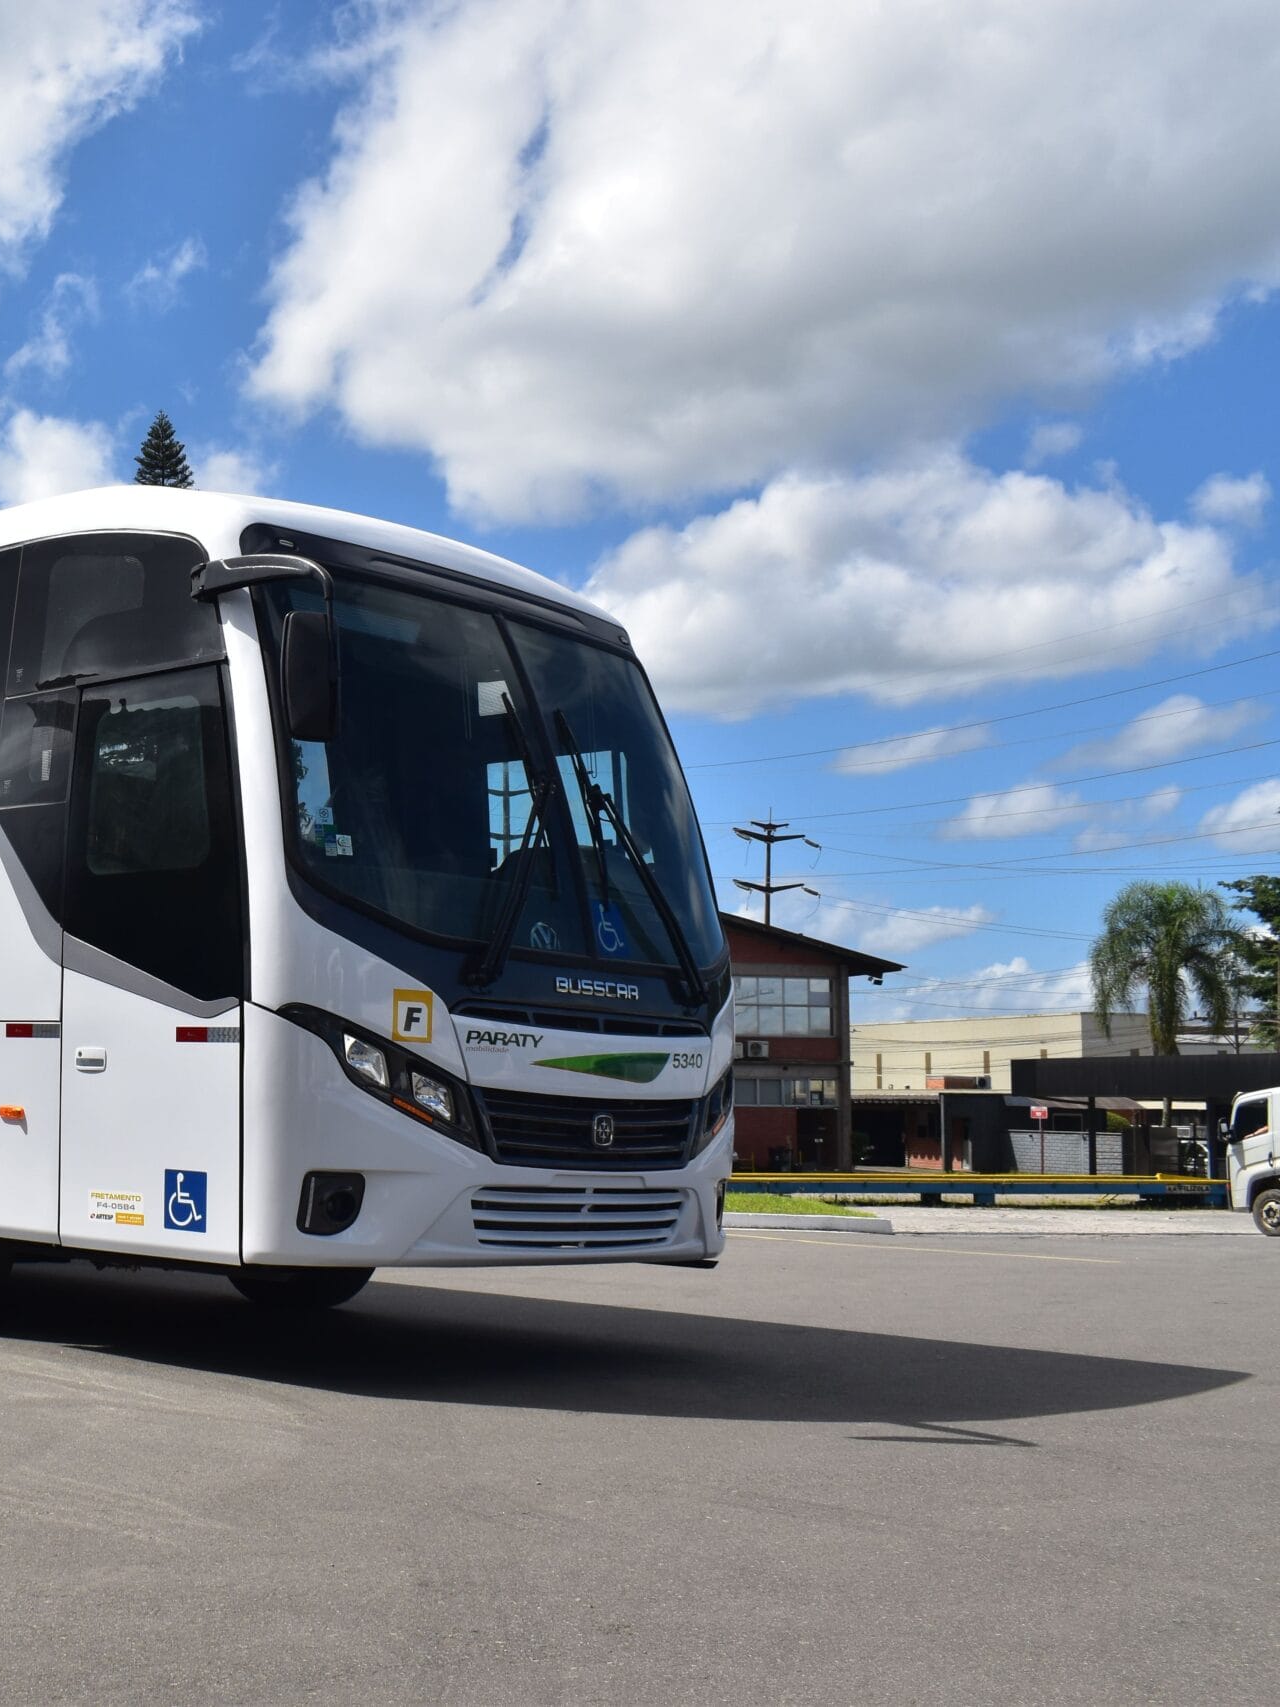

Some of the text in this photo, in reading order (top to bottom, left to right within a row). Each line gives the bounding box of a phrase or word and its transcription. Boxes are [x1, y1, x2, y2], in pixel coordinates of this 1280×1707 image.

[556, 977, 639, 1000] BUSSCAR
[403, 1007, 422, 1031] F
[465, 1030, 544, 1048] PARATY
[465, 1045, 510, 1054] mobilidade
[672, 1053, 703, 1068] 5340
[91, 1192, 142, 1202] FRETAMENTO
